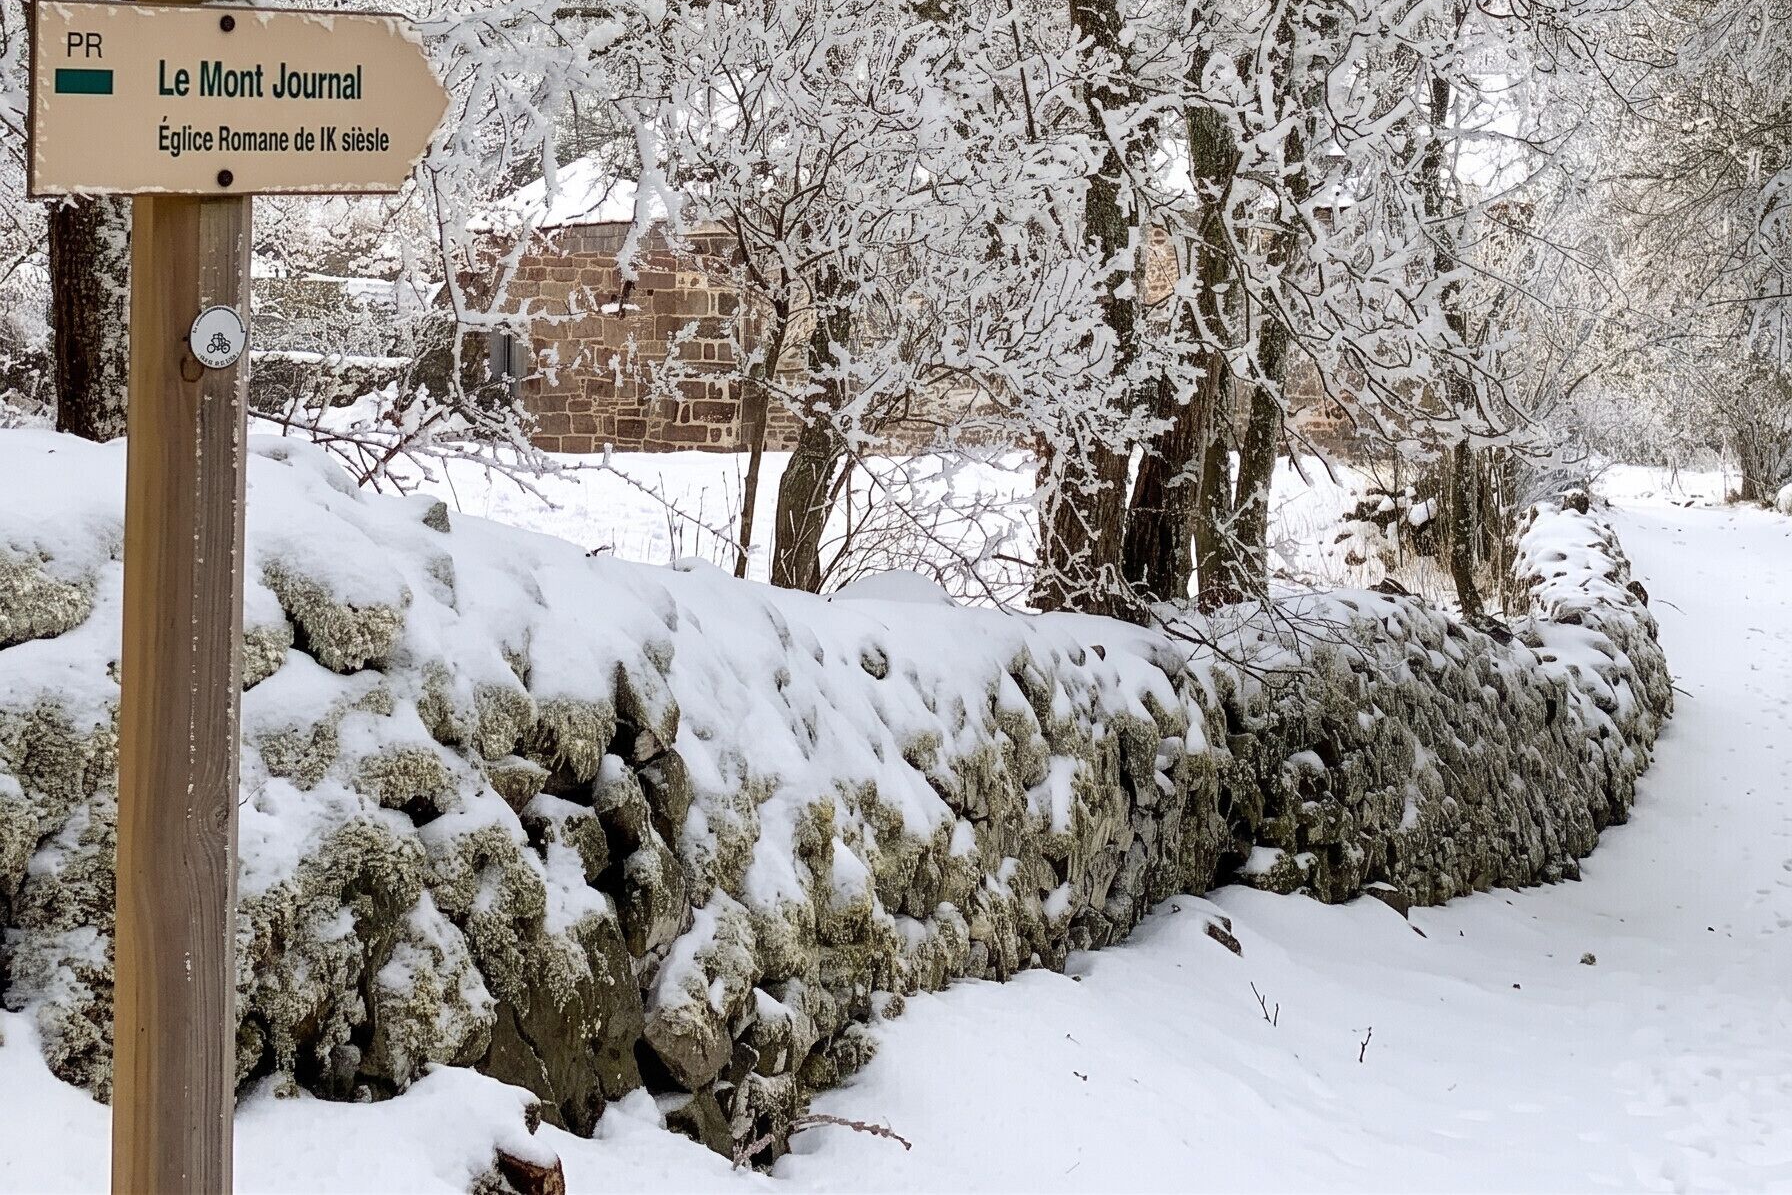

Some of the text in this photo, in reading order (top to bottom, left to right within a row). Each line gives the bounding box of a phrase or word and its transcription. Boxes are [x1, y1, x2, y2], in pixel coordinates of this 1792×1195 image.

[67, 31, 103, 59] PR
[158, 59, 362, 101] Le Mont Journal
[158, 115, 214, 158] Églice
[218, 125, 289, 152] Romane
[293, 126, 315, 152] de
[341, 126, 390, 152] sièsle
